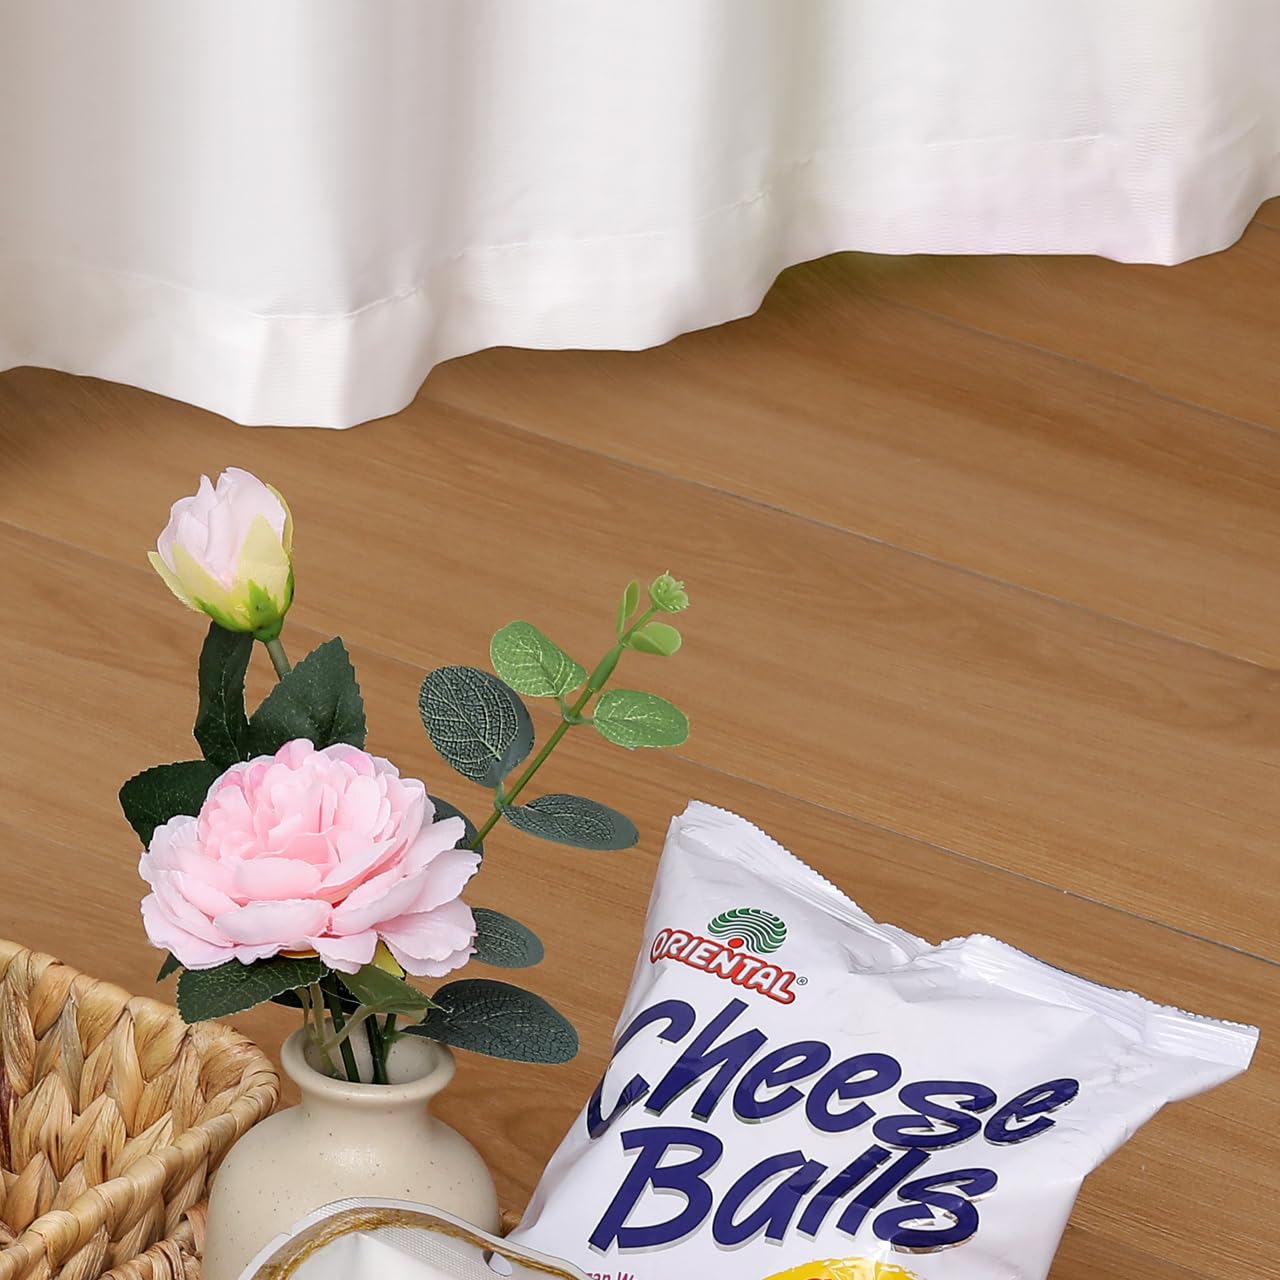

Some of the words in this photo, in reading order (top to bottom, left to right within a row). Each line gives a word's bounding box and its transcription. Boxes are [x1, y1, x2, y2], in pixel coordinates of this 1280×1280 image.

[650, 928, 796, 1004] ORIENTAL
[587, 998, 1080, 1152] Cheese
[588, 1125, 999, 1254] Balls
